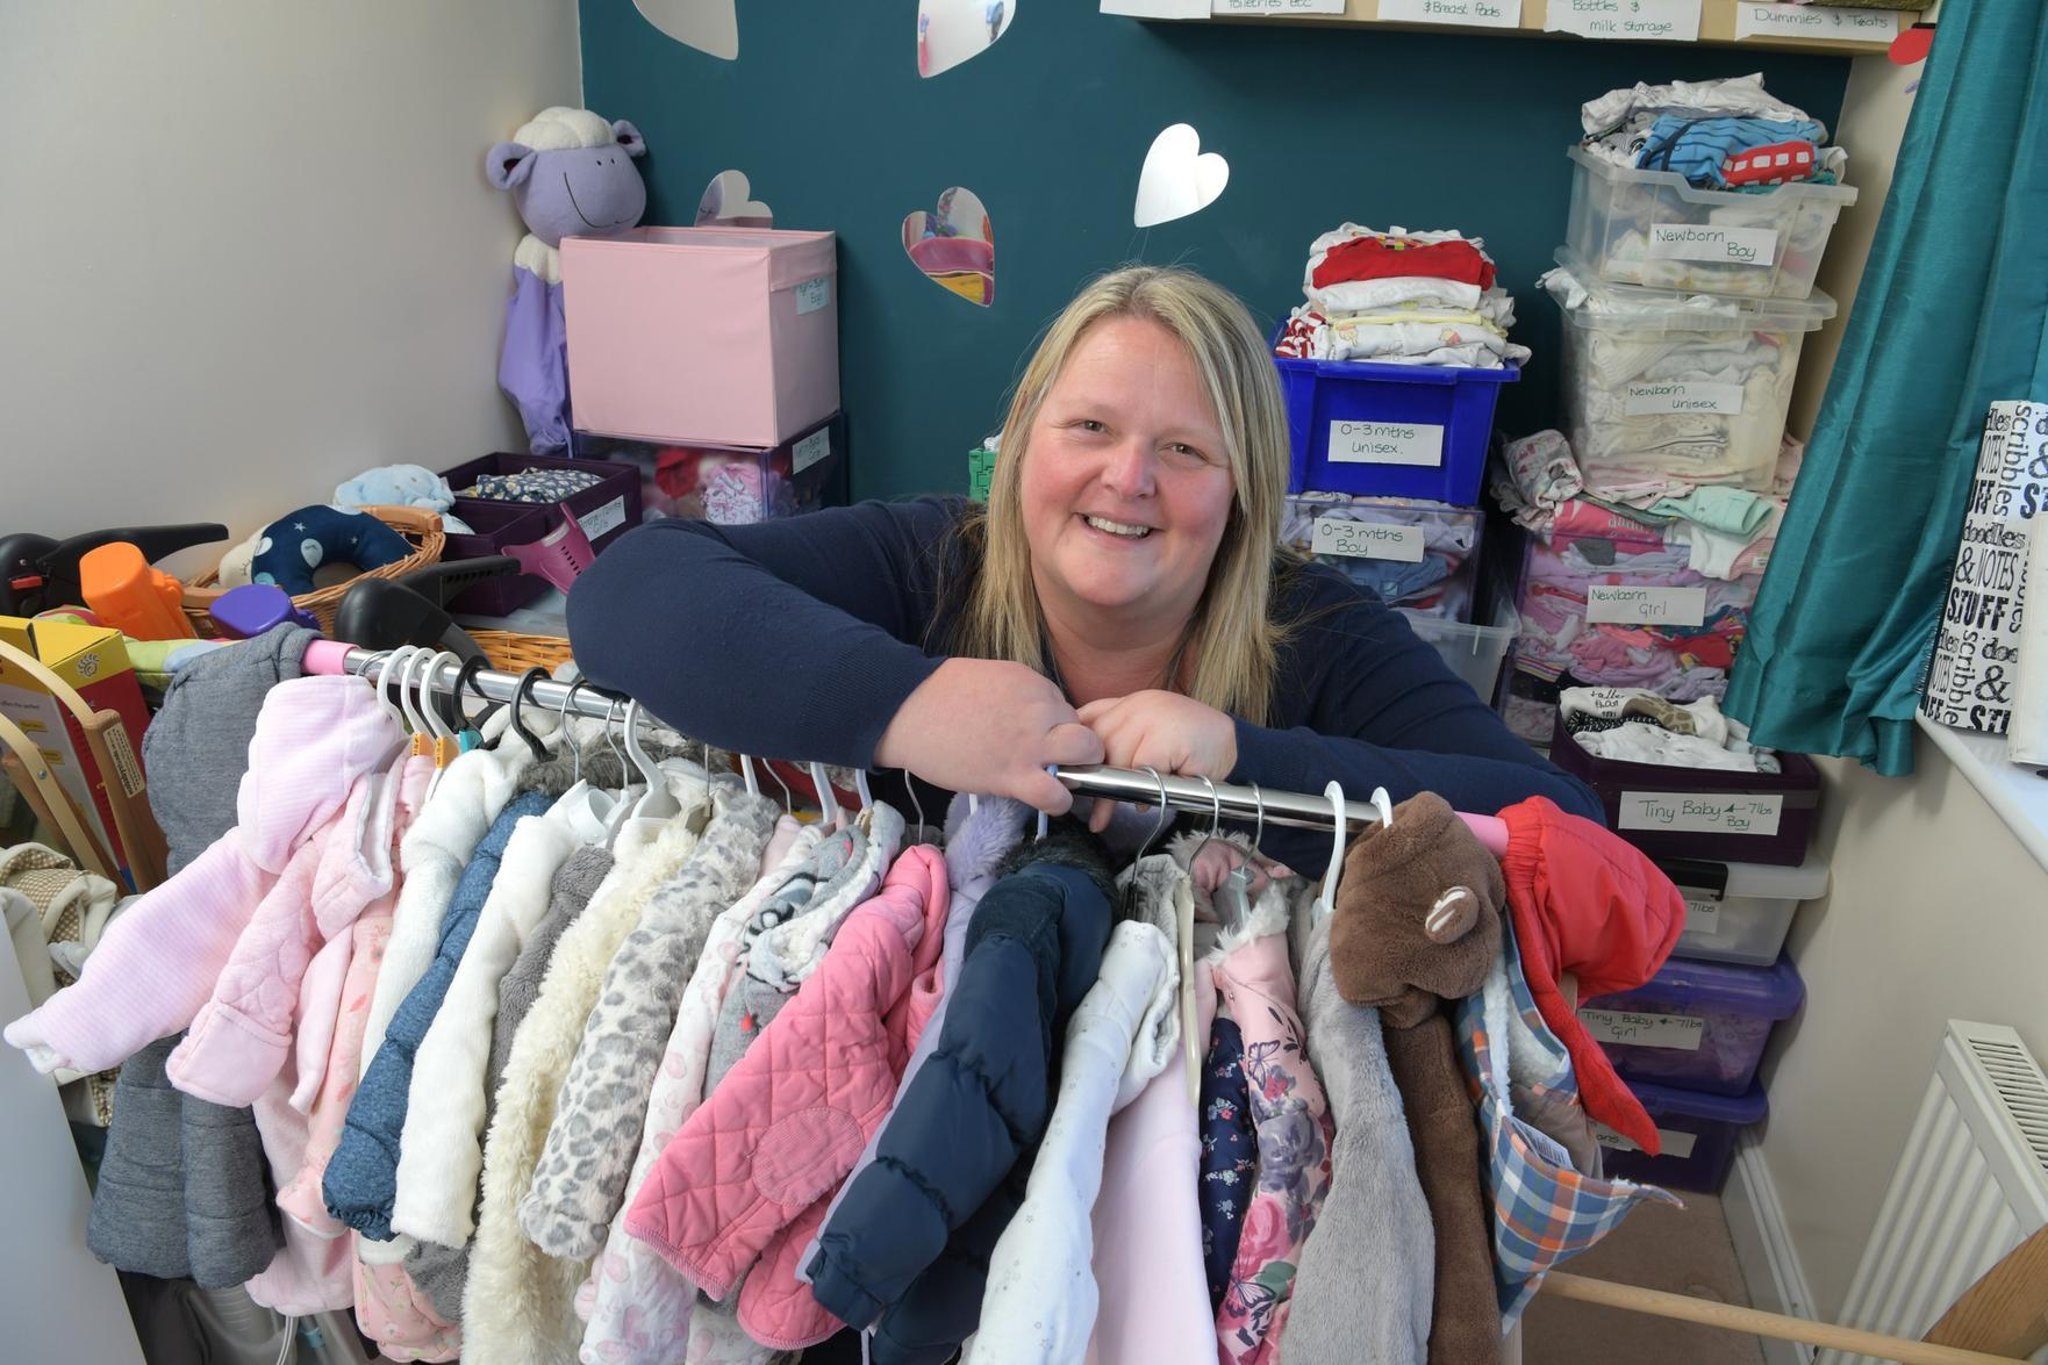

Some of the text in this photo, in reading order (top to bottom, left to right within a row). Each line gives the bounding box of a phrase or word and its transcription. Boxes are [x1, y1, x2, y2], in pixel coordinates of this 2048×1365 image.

[1754, 8, 1822, 25] Dummies
[1656, 228, 1725, 242] Newborn
[1727, 241, 1756, 262] Boy
[1630, 385, 1685, 397] Newborn
[1992, 404, 2032, 517] scribbles
[1321, 523, 1404, 542] 0-3 mths
[1962, 519, 2026, 550] doodles
[1336, 538, 1368, 556] Boy
[1955, 546, 1976, 584] &
[1974, 548, 2019, 591] NOTES
[1591, 588, 1648, 601] Newborn
[1947, 586, 2009, 631] STUFF
[1638, 799, 1676, 824] Tiny
[1682, 800, 1721, 822] Baby
[1727, 815, 1750, 831] Boy
[1582, 1011, 1613, 1026] Tiny
[1622, 1013, 1654, 1030] Baby
[1611, 1025, 1637, 1040] Girl
